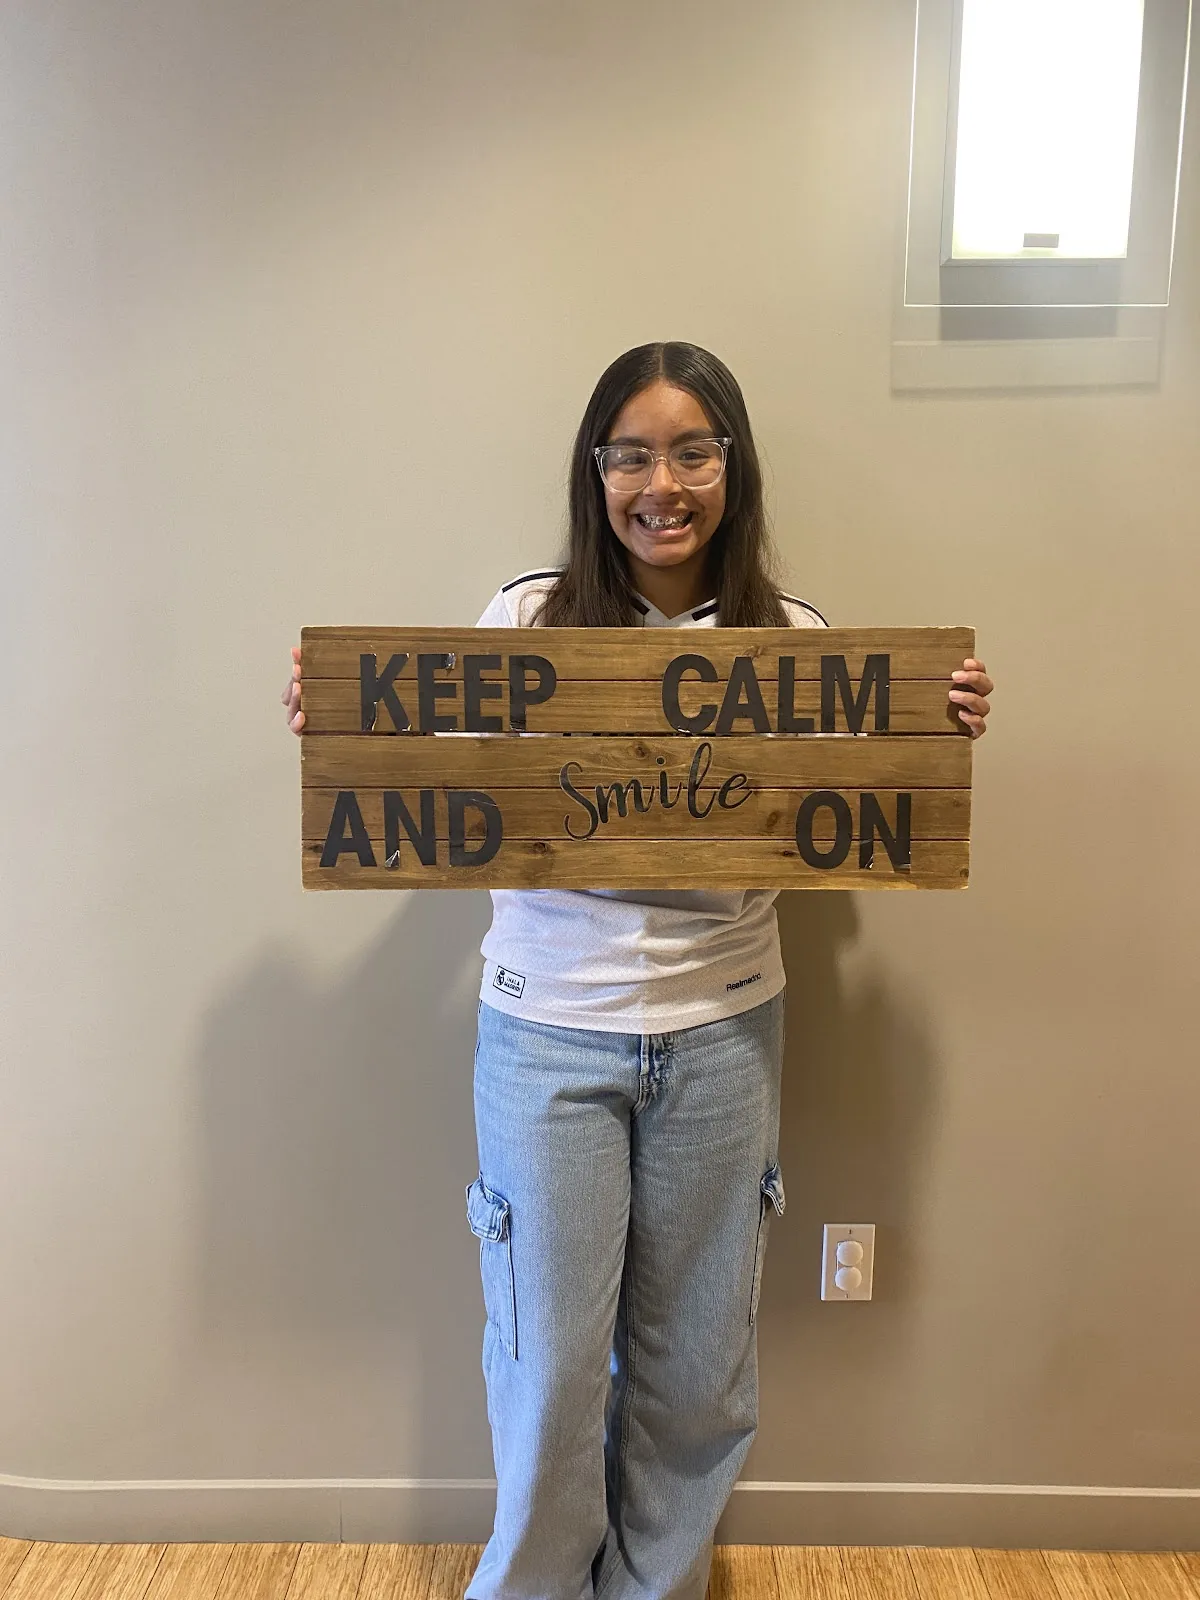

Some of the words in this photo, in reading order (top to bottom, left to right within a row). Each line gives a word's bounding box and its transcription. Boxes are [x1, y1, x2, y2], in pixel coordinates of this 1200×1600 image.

[360, 653, 557, 732] KEEP
[662, 653, 890, 734] CALM
[319, 790, 503, 868] AND
[560, 741, 754, 841] Smile
[795, 791, 912, 871] ON
